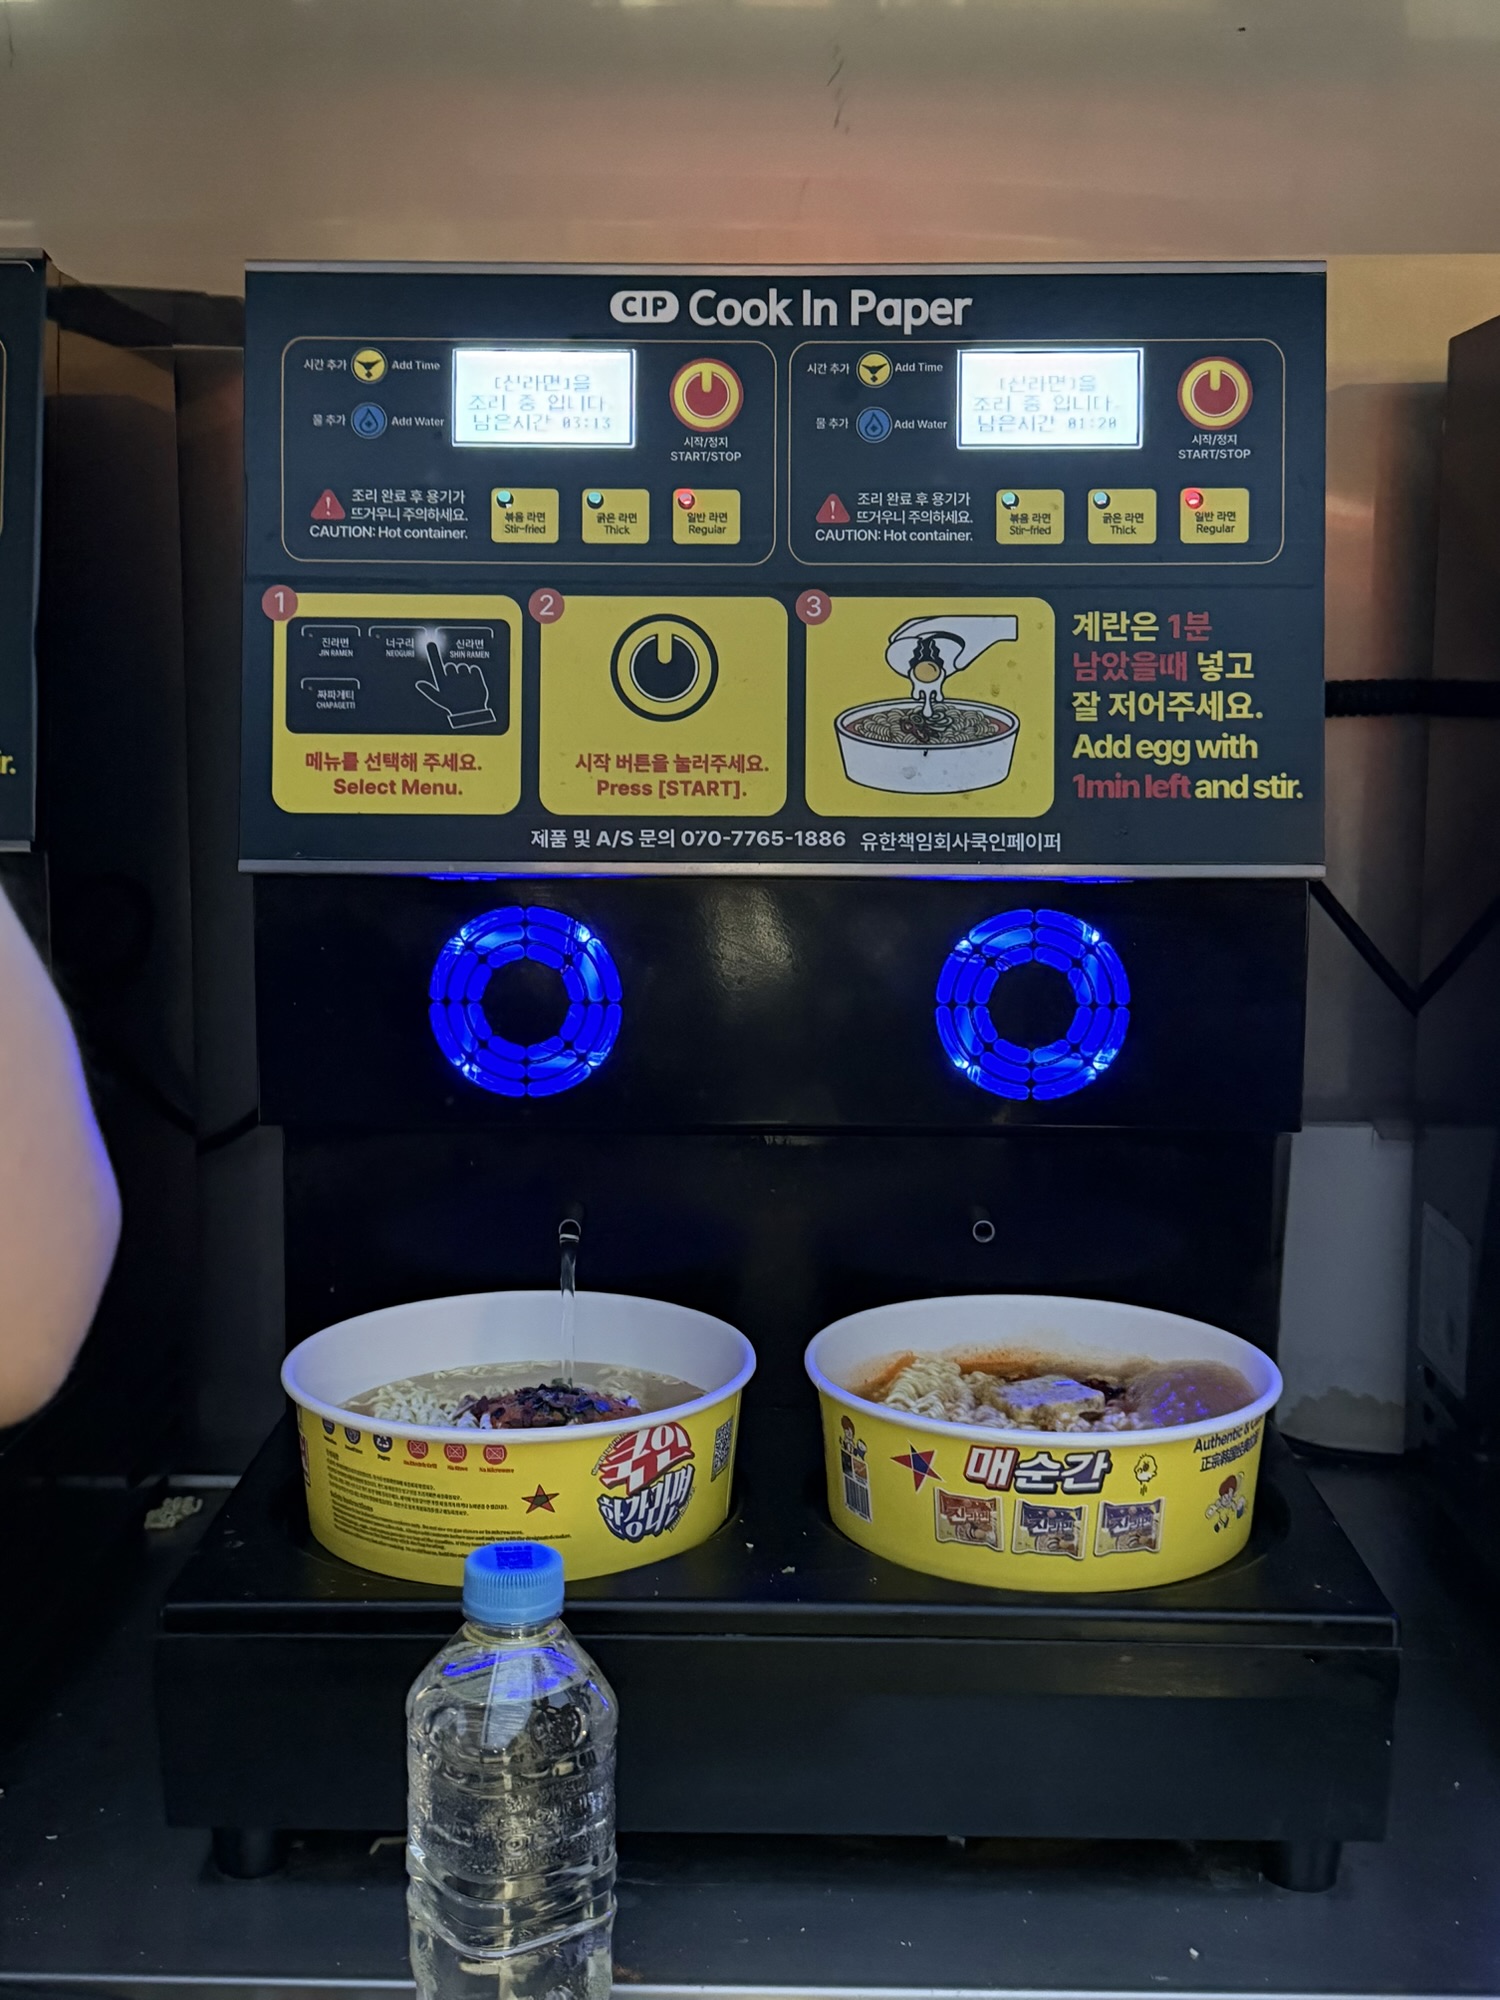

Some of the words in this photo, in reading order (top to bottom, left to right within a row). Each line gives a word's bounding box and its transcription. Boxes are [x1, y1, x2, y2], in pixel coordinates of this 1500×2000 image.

[621, 296, 668, 317] CIP
[689, 289, 793, 327] Cook
[802, 290, 838, 326] In
[850, 289, 973, 335] Paper
[304, 359, 325, 372] 시간
[327, 359, 347, 372] 추가
[392, 360, 411, 371] Add
[413, 360, 441, 371] Time
[807, 363, 828, 375] 시간
[830, 363, 850, 375] 추가
[895, 362, 913, 372] Add
[916, 362, 943, 372] Time
[468, 394, 506, 412] 조리
[519, 394, 536, 412] 중
[973, 395, 1011, 412] 조리
[1024, 395, 1041, 412] 중
[312, 414, 324, 427] 물
[325, 414, 346, 427] 추가
[392, 416, 411, 427] Add
[413, 416, 444, 427] Water
[473, 414, 551, 432] 남은시간
[562, 416, 611, 430] 03:13
[816, 418, 827, 430] 물
[828, 418, 849, 430] 추가
[894, 419, 913, 430] Add
[915, 419, 947, 430] Water
[978, 414, 1055, 433] 남은시간
[1068, 416, 1117, 430] 01:20
[683, 436, 729, 450] 시작/정지
[1191, 433, 1238, 447] 시작/정지
[670, 451, 742, 463] START/STOP
[1178, 449, 1251, 460] START/STOP
[352, 489, 378, 504] 조리
[381, 489, 406, 504] 완료
[409, 489, 423, 504] 후
[425, 489, 466, 504] 용기가
[857, 492, 883, 507] 조리
[886, 492, 913, 507] 완료
[916, 492, 930, 507] 후
[931, 492, 970, 507] 용기가
[351, 507, 401, 522] 뜨거우니
[403, 507, 468, 522] 주의하세요.
[527, 512, 546, 524] 라면
[618, 513, 637, 525] 라면
[687, 513, 707, 525] 일반
[709, 513, 728, 525] 라면
[856, 510, 907, 525] 뜨거우니
[908, 510, 973, 525] 주의하세요.
[1031, 512, 1051, 524] 라면
[1125, 512, 1144, 524] 라면
[1195, 511, 1214, 523] 일반
[1217, 511, 1236, 523] 라면
[309, 525, 376, 538] CAUTION:
[378, 526, 402, 538] Hot
[403, 527, 468, 540] container.
[504, 524, 546, 535] Stir-fried
[603, 524, 631, 535] Thick
[688, 524, 727, 537] Regular
[815, 528, 882, 541] CAUTION:
[883, 529, 908, 541] Hot
[909, 529, 973, 541] container.
[1009, 524, 1052, 536] Stir-fried
[1110, 524, 1137, 535] Thick
[1196, 522, 1235, 535] Regular
[274, 592, 286, 612] 1
[539, 595, 554, 615] 2
[806, 596, 822, 617] 3
[1072, 611, 1160, 642] 계란은
[1168, 611, 1212, 642] 1분
[321, 637, 350, 649] 진라면
[386, 637, 415, 649] 너구리
[456, 638, 485, 650] 신라면
[318, 649, 330, 657] JIN
[330, 649, 353, 657] RAMEN
[386, 650, 415, 658] NEOGURI
[450, 650, 466, 659] SHIN
[467, 650, 490, 659] RAMEN
[1073, 651, 1188, 682] 남았을때
[1197, 651, 1254, 682] 넣고
[317, 690, 355, 701] 짜파게티
[316, 701, 356, 709] CHAPAGETTI
[1072, 691, 1101, 722] 잘
[1108, 691, 1263, 722] 저어주세요.
[1072, 734, 1134, 759] Add
[1136, 740, 1191, 765] egg
[1196, 734, 1258, 759] with
[305, 752, 358, 771] 메뉴를
[364, 752, 418, 772] 선택해
[422, 752, 482, 772] 주세요.
[575, 753, 609, 773] 시작
[615, 753, 669, 773] 버튼을
[674, 753, 769, 773] 눌러주세요.
[333, 778, 397, 795] Select
[401, 778, 463, 795] Menu.
[597, 779, 653, 796] Press
[658, 779, 747, 799] [START].
[1073, 773, 1140, 798] 1min
[1144, 773, 1193, 798] left
[1195, 774, 1249, 799] and
[1253, 774, 1303, 799] stir.
[531, 829, 568, 849] 제품
[573, 829, 591, 848] 및
[596, 830, 634, 847] A/S
[639, 830, 675, 848] 문의
[681, 830, 846, 847] 070-7765-1886
[860, 832, 1061, 852] 유한책임회사쿡인페이퍼
[964, 1445, 1112, 1494] 매순간
[598, 1464, 694, 1540] 한강라면
